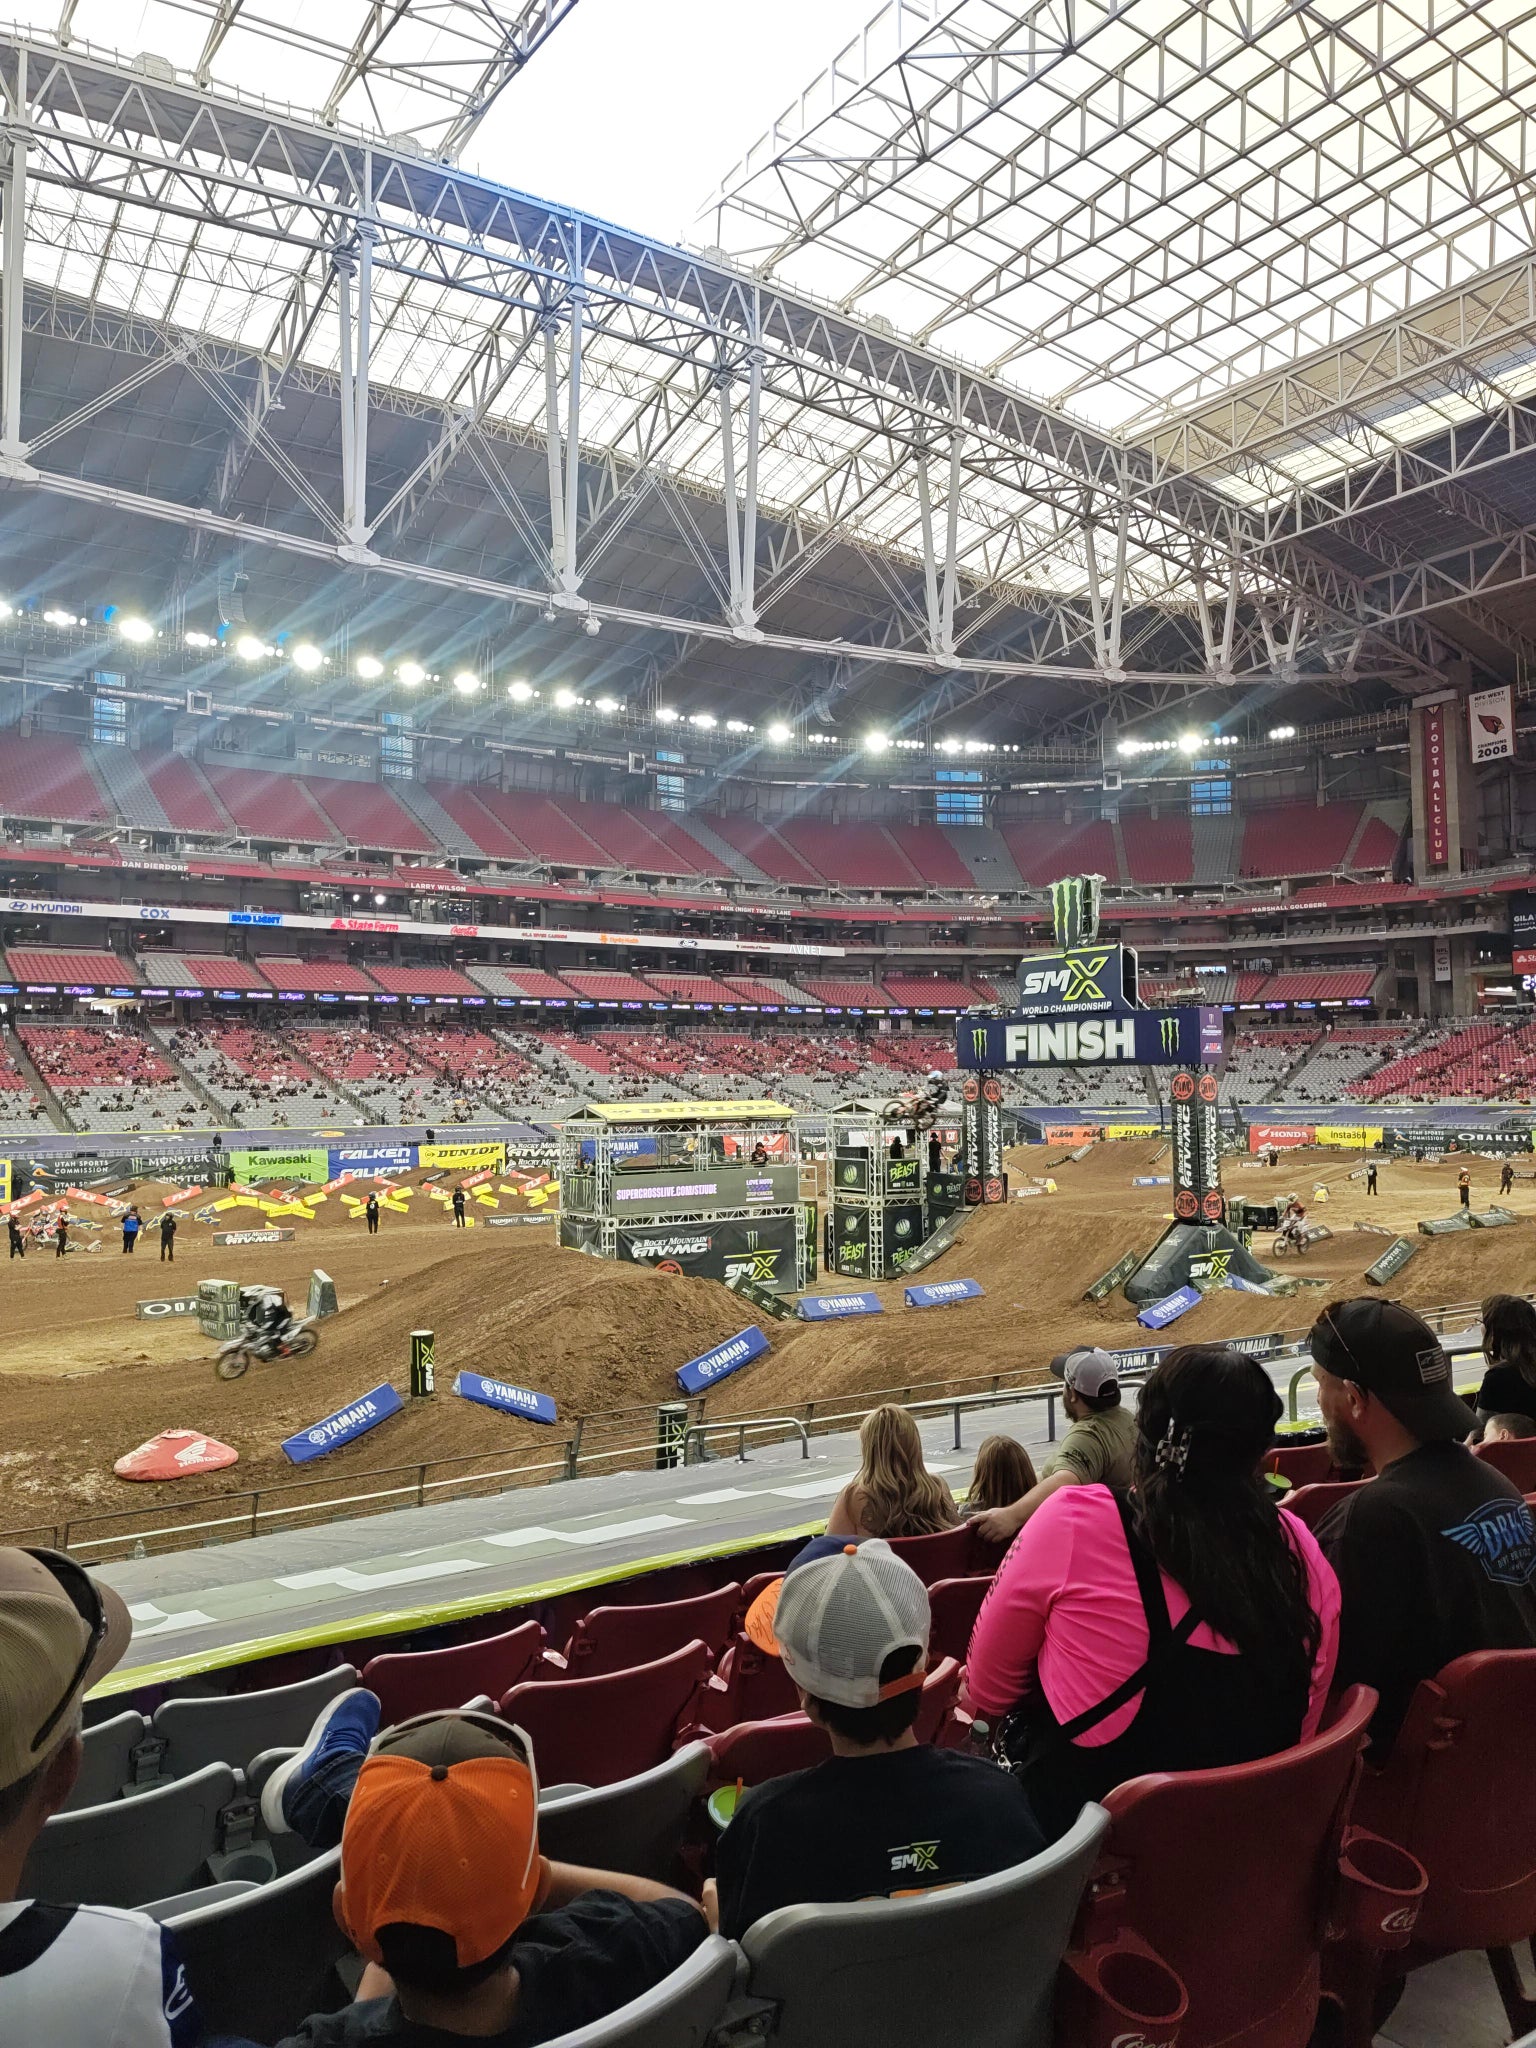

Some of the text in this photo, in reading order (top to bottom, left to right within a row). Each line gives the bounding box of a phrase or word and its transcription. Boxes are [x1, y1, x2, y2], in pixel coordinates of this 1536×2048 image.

[1488, 690, 1504, 698] WEST
[1474, 696, 1506, 708] DIVISION
[1478, 738, 1507, 749] CHAMPIONS
[1478, 744, 1508, 758] 2008
[144, 862, 189, 872] DIERDORF
[410, 882, 435, 890] LARRY
[438, 884, 467, 892] WILSON
[31, 902, 83, 914] HYUNDAI
[1290, 902, 1328, 910] GOLDBERG
[140, 908, 170, 918] COX
[232, 914, 281, 924] BUD LIGHT
[1514, 914, 1534, 922] GILA
[348, 920, 399, 932] State Farm
[789, 944, 824, 956] AVNET
[1022, 956, 1110, 1001] SMX
[1022, 1001, 1112, 1015] WORLD CHAMPIONSHIP
[1005, 1018, 1136, 1062] FINISH
[1330, 1130, 1367, 1139] Insta360
[1476, 1133, 1528, 1142] OAKLEY
[339, 1148, 411, 1160] FALKEN
[436, 1146, 500, 1158] DUNLOP
[79, 1160, 109, 1168] SPORTS
[148, 1154, 210, 1166] MONSTER
[248, 1154, 312, 1166] Kawasaki
[468, 1172, 486, 1185] FLY
[890, 1162, 918, 1182] BEAST
[329, 1176, 346, 1190] FLY
[525, 1176, 542, 1190] FLY
[75, 1192, 97, 1202] FLY
[172, 1189, 192, 1202] FLY
[644, 1236, 708, 1246] ROCKY MOUNTAIN
[839, 1242, 868, 1263] BEAST
[724, 1255, 778, 1280] SMX
[1189, 1254, 1232, 1279] SMX
[933, 1282, 968, 1295] YAMAHA
[828, 1296, 866, 1310] YAMAHA
[1160, 1294, 1188, 1314] YAMAHA
[1234, 1338, 1270, 1352] YAMAHA
[708, 1340, 750, 1368] YAMAHA
[1122, 1352, 1160, 1368] YAMAA
[708, 1350, 750, 1377] RACING
[486, 1392, 536, 1410] RACING
[493, 1384, 538, 1406] YAMAHA
[322, 1400, 377, 1436] YAMAHA
[320, 1412, 376, 1446] RACING
[178, 1456, 220, 1468] HONDA
[890, 1846, 940, 1872] SMX
